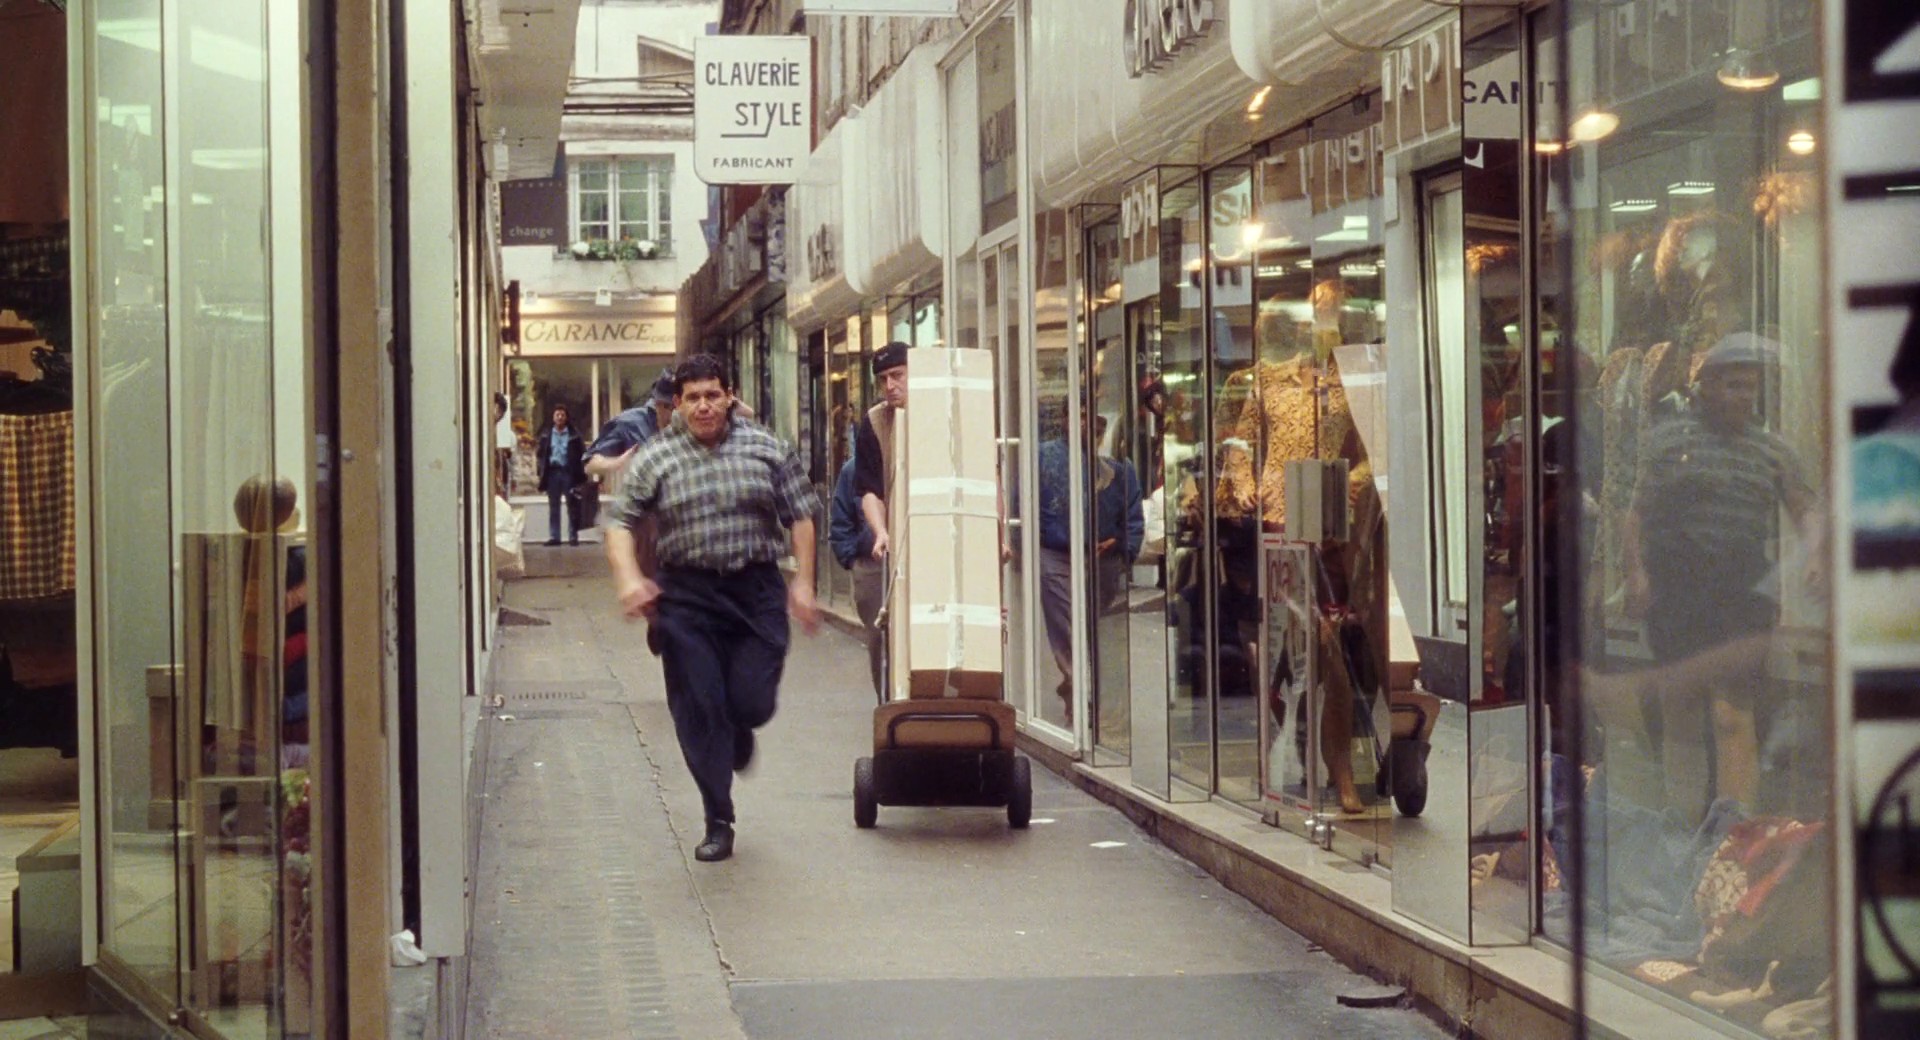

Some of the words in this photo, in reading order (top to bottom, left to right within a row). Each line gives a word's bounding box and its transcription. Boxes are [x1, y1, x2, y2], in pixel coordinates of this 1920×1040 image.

[705, 57, 800, 86] CLAVERiE
[724, 102, 802, 138] STYLE
[713, 157, 794, 169] FABRICANT
[524, 320, 653, 343] GARANCE
